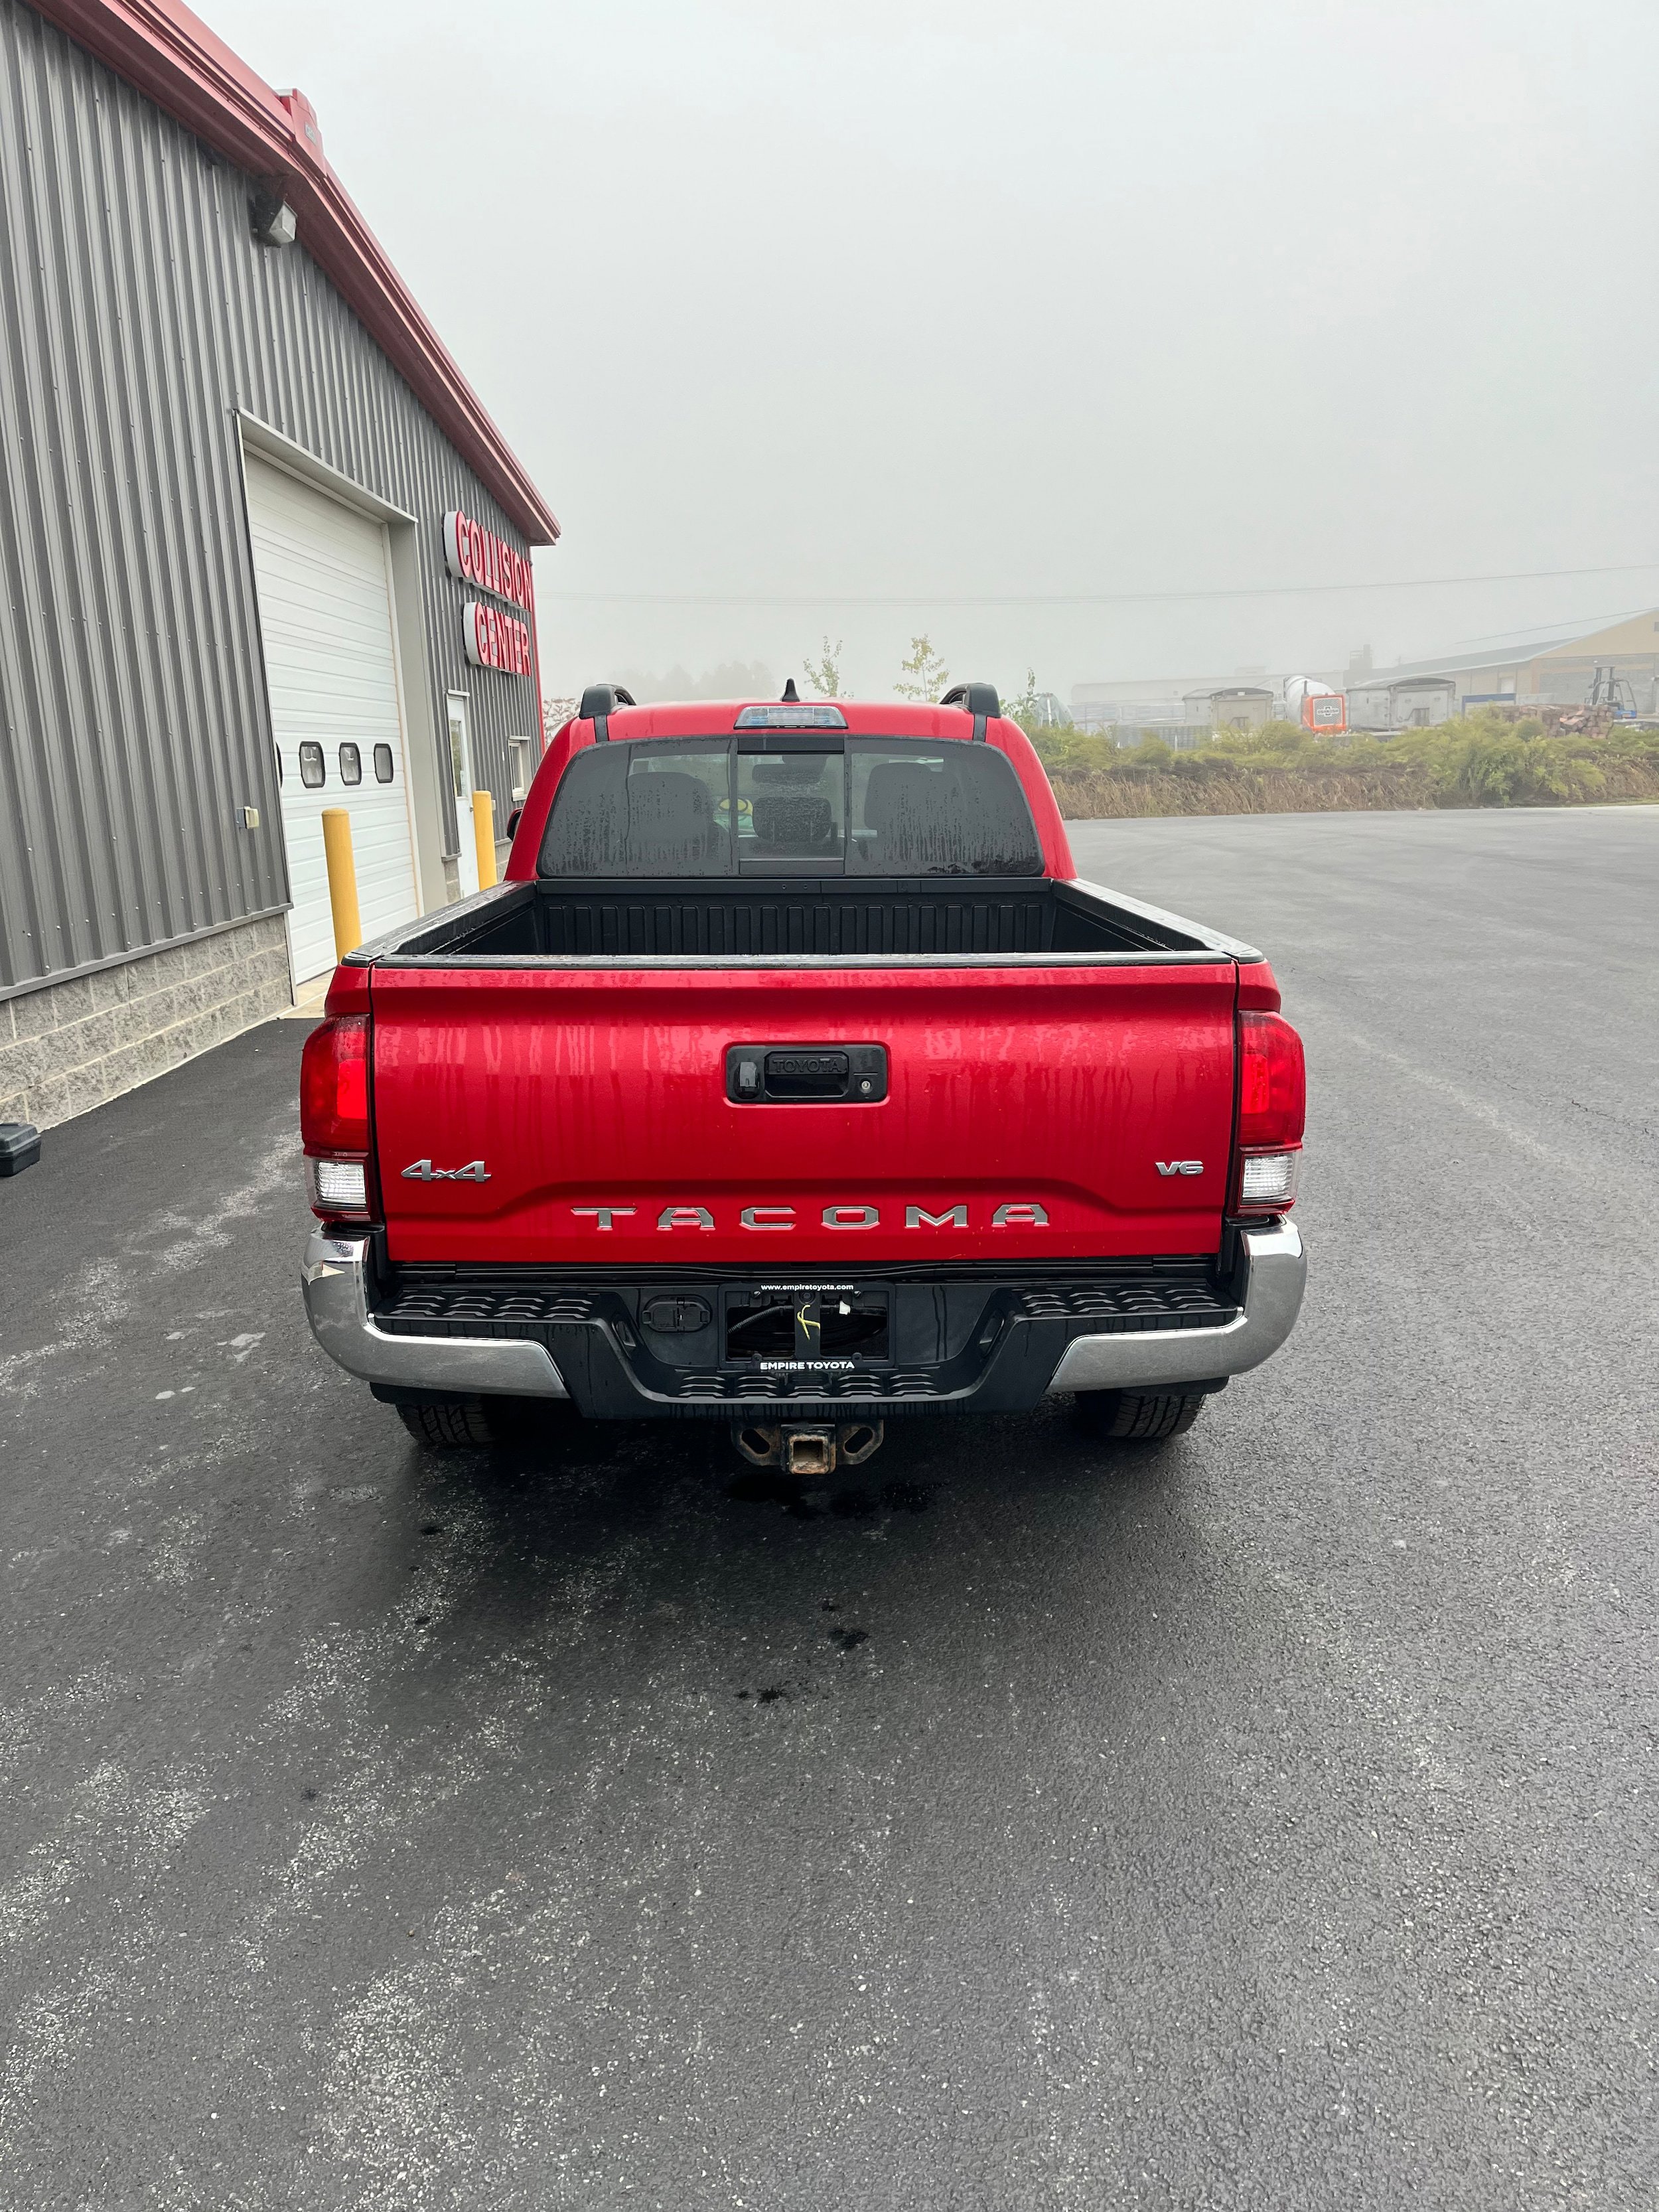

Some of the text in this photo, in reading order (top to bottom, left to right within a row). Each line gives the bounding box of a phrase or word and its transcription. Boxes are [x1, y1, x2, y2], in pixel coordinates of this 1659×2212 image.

[455, 510, 532, 612] COLLISION
[474, 601, 532, 677] CENTER
[772, 1059, 842, 1073] TOYOTA
[401, 1159, 492, 1182] 4x4
[1155, 1161, 1204, 1175] V6
[571, 1204, 1049, 1232] TACOMA
[760, 1362, 805, 1370] EMPIRE
